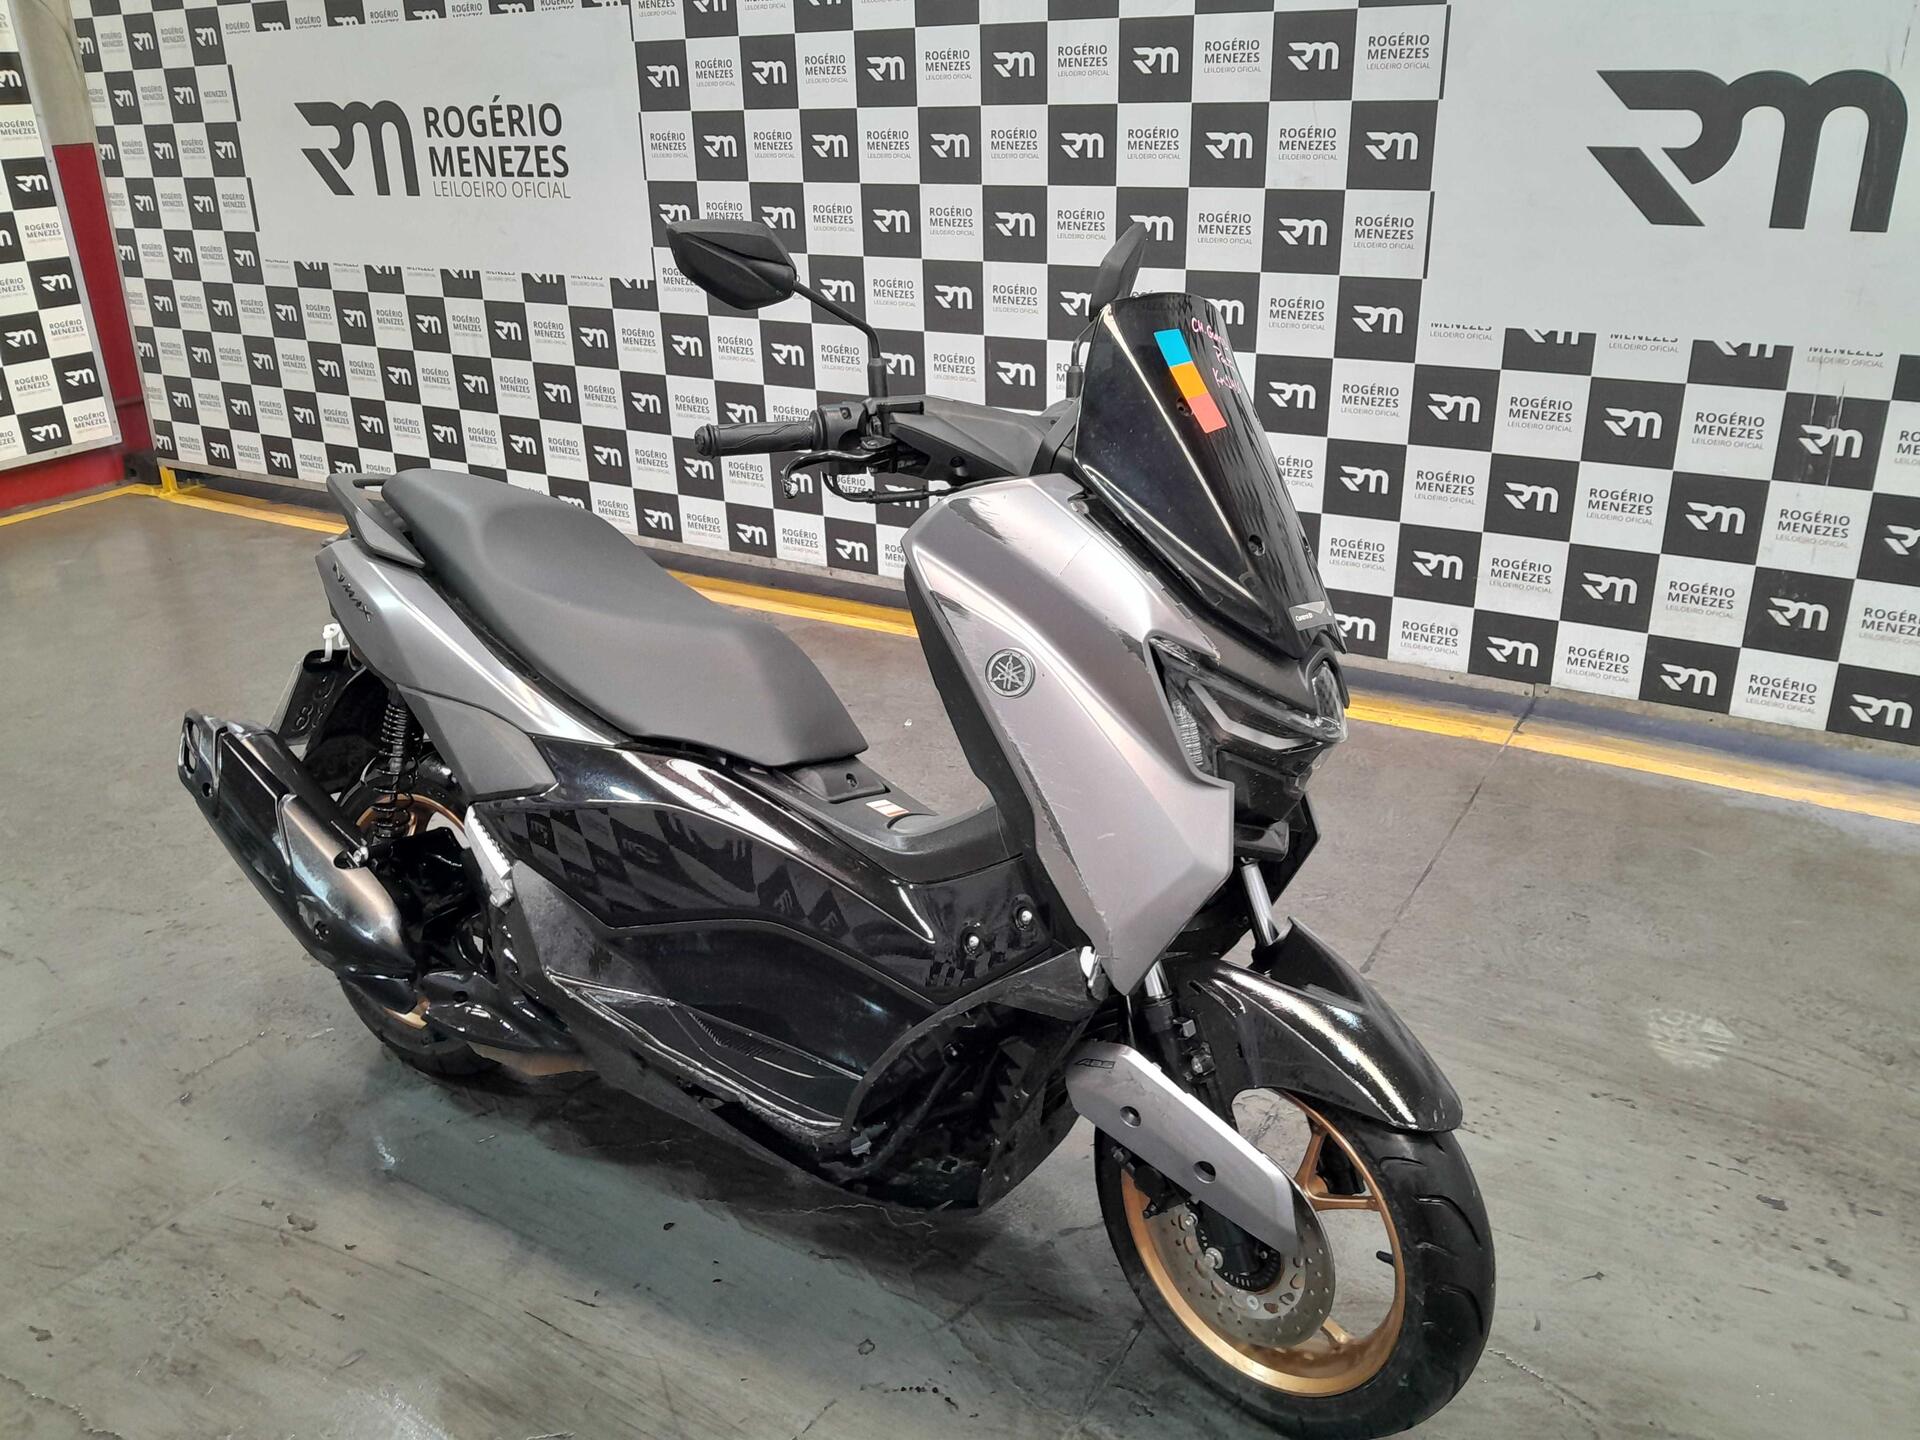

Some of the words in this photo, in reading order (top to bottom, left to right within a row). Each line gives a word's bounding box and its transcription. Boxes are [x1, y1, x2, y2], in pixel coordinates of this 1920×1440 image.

[1205, 38, 1260, 51] ROGÉRIO
[1368, 32, 1429, 47] ROGÉRIO
[925, 48, 970, 60] ROGÉRIO
[1058, 43, 1107, 56] ROGÉRIO
[1367, 47, 1429, 60] MENEZES
[695, 58, 732, 69] ROGÉRIO
[804, 53, 845, 65] ROGÉRIO
[1058, 56, 1108, 68] MENEZES
[1204, 52, 1260, 64] MENEZES
[805, 65, 846, 75] MENEZES
[925, 61, 971, 71] MENEZES
[695, 69, 734, 79] MENEZES
[423, 95, 562, 138] ROGÉRIO
[650, 131, 685, 141] ROGÉRIO
[753, 129, 792, 140] ROGÉRIO
[867, 128, 909, 139] ROGÉRIO
[991, 127, 1037, 139] ROGÉRIO
[1128, 126, 1179, 138] ROGÉRIO
[1279, 125, 1336, 138] ROGÉRIO
[651, 142, 687, 150] MENEZES
[754, 141, 793, 150] MENEZES
[867, 141, 910, 150] MENEZES
[991, 141, 1037, 150] MENEZES
[1128, 140, 1179, 150] MENEZES
[1279, 140, 1336, 150] MENEZES
[428, 144, 569, 178] MENEZES
[432, 180, 507, 198] LEILOEIRO
[512, 181, 572, 199] OFICIAL
[812, 203, 852, 214] ROGÉRIO
[929, 205, 973, 217] ROGÉRIO
[1057, 208, 1105, 220] ROGÉRIO
[813, 214, 853, 224] MENEZES
[929, 218, 973, 227] MENEZES
[1198, 211, 1251, 223] ROGÉRIO
[1355, 215, 1414, 228] ROGÉRIO
[25, 221, 59, 231] ROGÉRIO
[1057, 221, 1105, 231] MENEZES
[1198, 224, 1251, 235] MENEZES
[26, 229, 61, 238] MENEZES
[1354, 229, 1413, 240] MENEZES
[873, 278, 914, 289] ROGÉRIO
[873, 289, 914, 299] MENEZES
[992, 284, 1037, 295] ROGÉRIO
[993, 295, 1038, 306] MENEZES
[1270, 297, 1324, 310] ROGÉRIO
[305, 303, 330, 312] ROGÉRIO
[376, 308, 402, 318] ROGÉRIO
[307, 311, 332, 320] MENEZES
[452, 314, 480, 324] ROGÉRIO
[1269, 309, 1324, 321] MENEZES
[49, 319, 82, 329] ROGÉRIO
[377, 317, 404, 325] MENEZES
[533, 320, 564, 330] ROGÉRIO
[51, 326, 84, 336] MENEZES
[453, 323, 482, 332] MENEZES
[621, 328, 654, 338] ROGÉRIO
[534, 329, 565, 339] MENEZES
[622, 337, 656, 347] MENEZES
[421, 367, 449, 377] ROGÉRIO
[14, 374, 48, 385] ROGÉRIO
[422, 375, 450, 384] MENEZES
[499, 375, 529, 385] ROGÉRIO
[16, 381, 50, 392] MENEZES
[500, 384, 530, 393] MENEZES
[583, 384, 615, 394] ROGÉRIO
[1343, 384, 1399, 397] ROGÉRIO
[584, 393, 616, 403] MENEZES
[1342, 395, 1398, 408] MENEZES
[1510, 397, 1572, 411] ROGÉRIO
[73, 411, 105, 422] ROGÉRIO
[1508, 408, 1571, 423] MENEZES
[1695, 412, 1765, 427] ROGÉRIO
[75, 418, 107, 429] MENEZES
[1693, 424, 1763, 440] MENEZES
[548, 437, 578, 447] ROGÉRIO
[549, 445, 579, 456] MENEZES
[635, 449, 667, 459] ROGÉRIO
[636, 457, 669, 468] MENEZES
[1417, 470, 1474, 484] ROGÉRIO
[1416, 481, 1474, 496] MENEZES
[1589, 488, 1653, 504] ROGÉRIO
[1587, 500, 1652, 516] MENEZES
[1669, 581, 1735, 598] ROGÉRIO
[1667, 592, 1734, 609] MENEZES
[1749, 674, 1818, 693] ROGÉRIO
[1747, 685, 1816, 705] MENEZES
